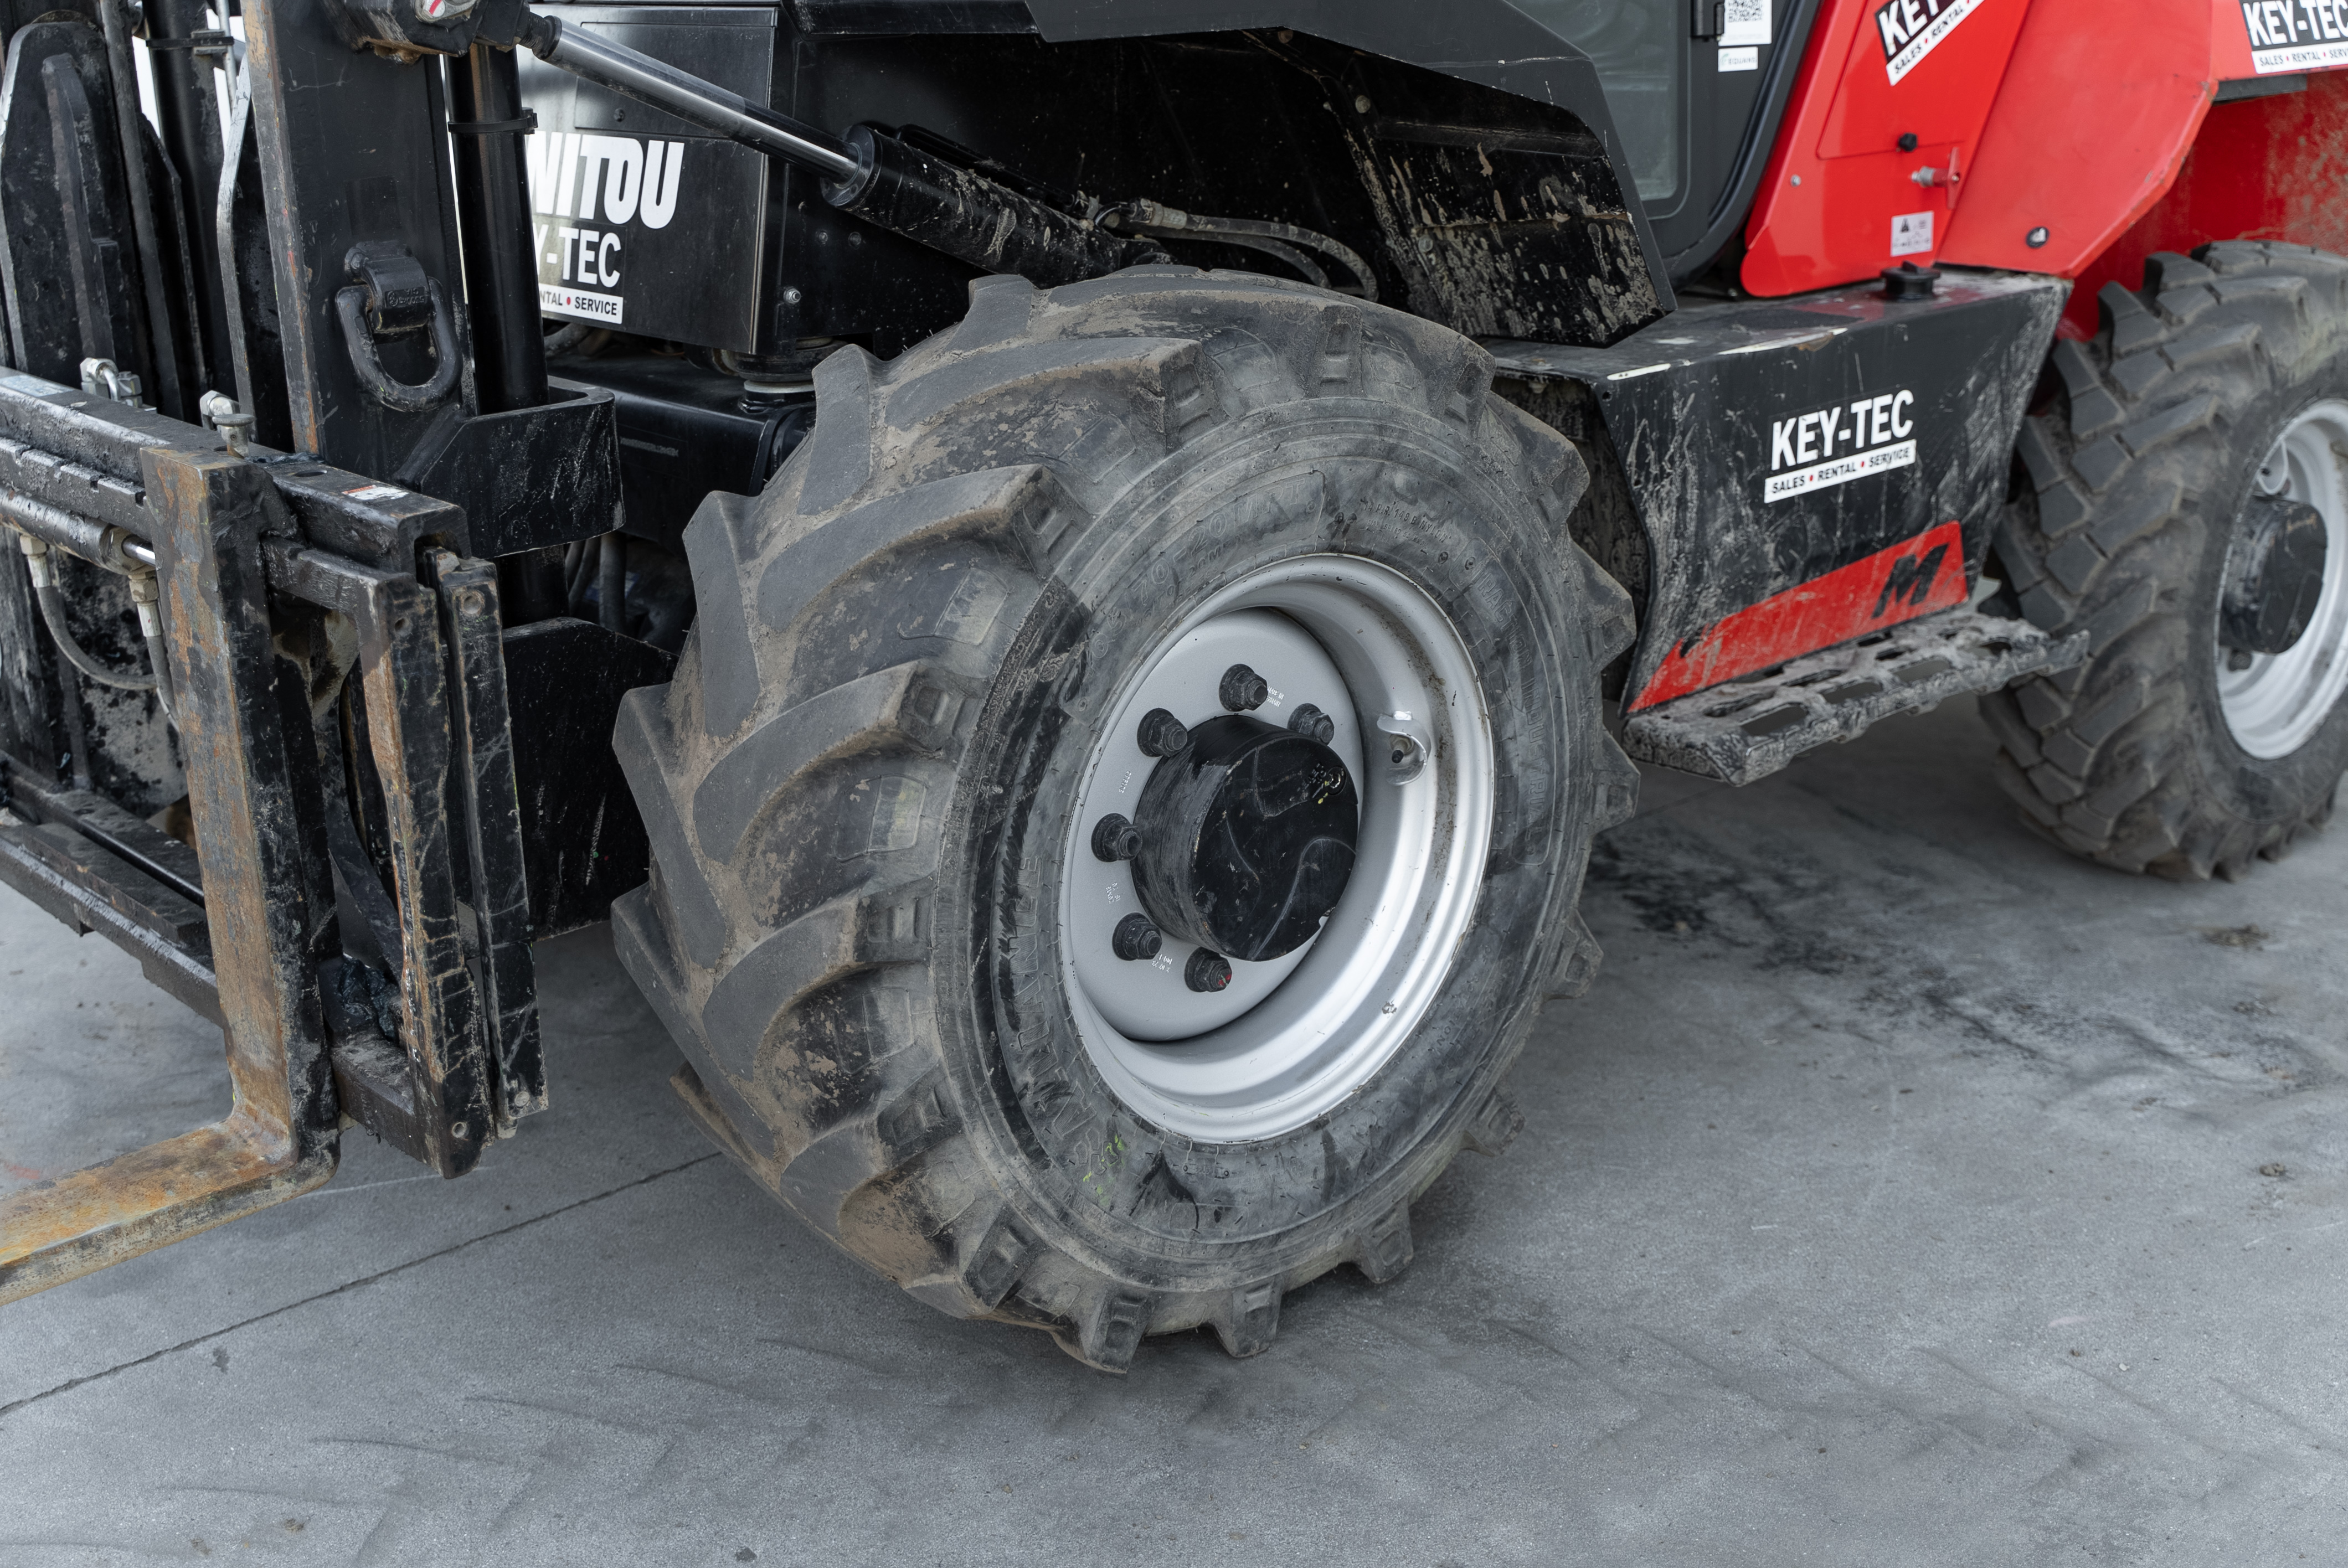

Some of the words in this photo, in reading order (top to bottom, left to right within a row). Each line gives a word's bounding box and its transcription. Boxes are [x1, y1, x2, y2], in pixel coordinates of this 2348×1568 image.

[1894, 44, 1923, 74] SALES
[1932, 5, 1964, 39] RENTAL
[2260, 55, 2283, 66] SALES
[2293, 51, 2321, 63] RENTAL
[2329, 49, 2348, 58] SERV
[526, 131, 684, 229] NITOU
[533, 223, 621, 288] Y-TEC
[540, 292, 563, 306] NTAL
[575, 296, 617, 316] SERVICE
[1771, 389, 1914, 471] KEY-TEC
[1772, 475, 1805, 494] SALES
[1818, 462, 1857, 481] RENTAL
[1868, 446, 1911, 467] SERVICE
